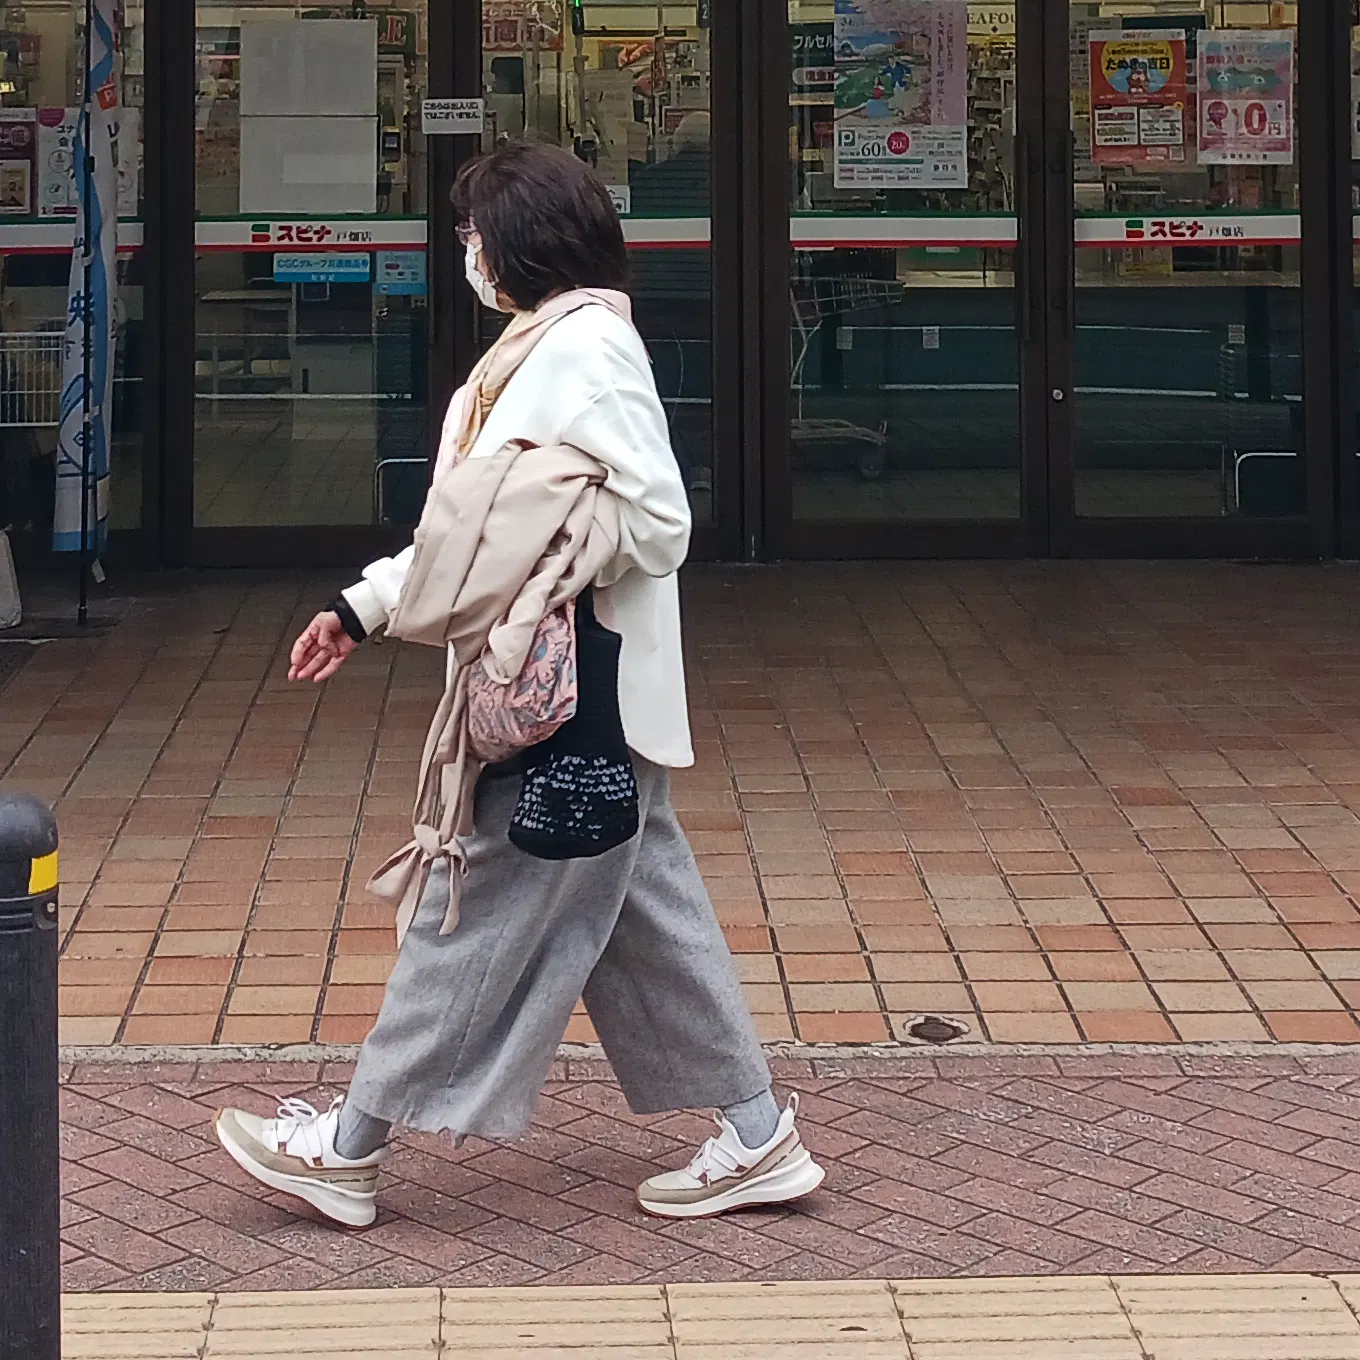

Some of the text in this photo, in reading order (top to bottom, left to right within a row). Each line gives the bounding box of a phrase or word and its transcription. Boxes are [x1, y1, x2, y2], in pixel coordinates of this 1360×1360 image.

[277, 224, 333, 242] スピナ
[1149, 220, 1205, 238] スピナ
